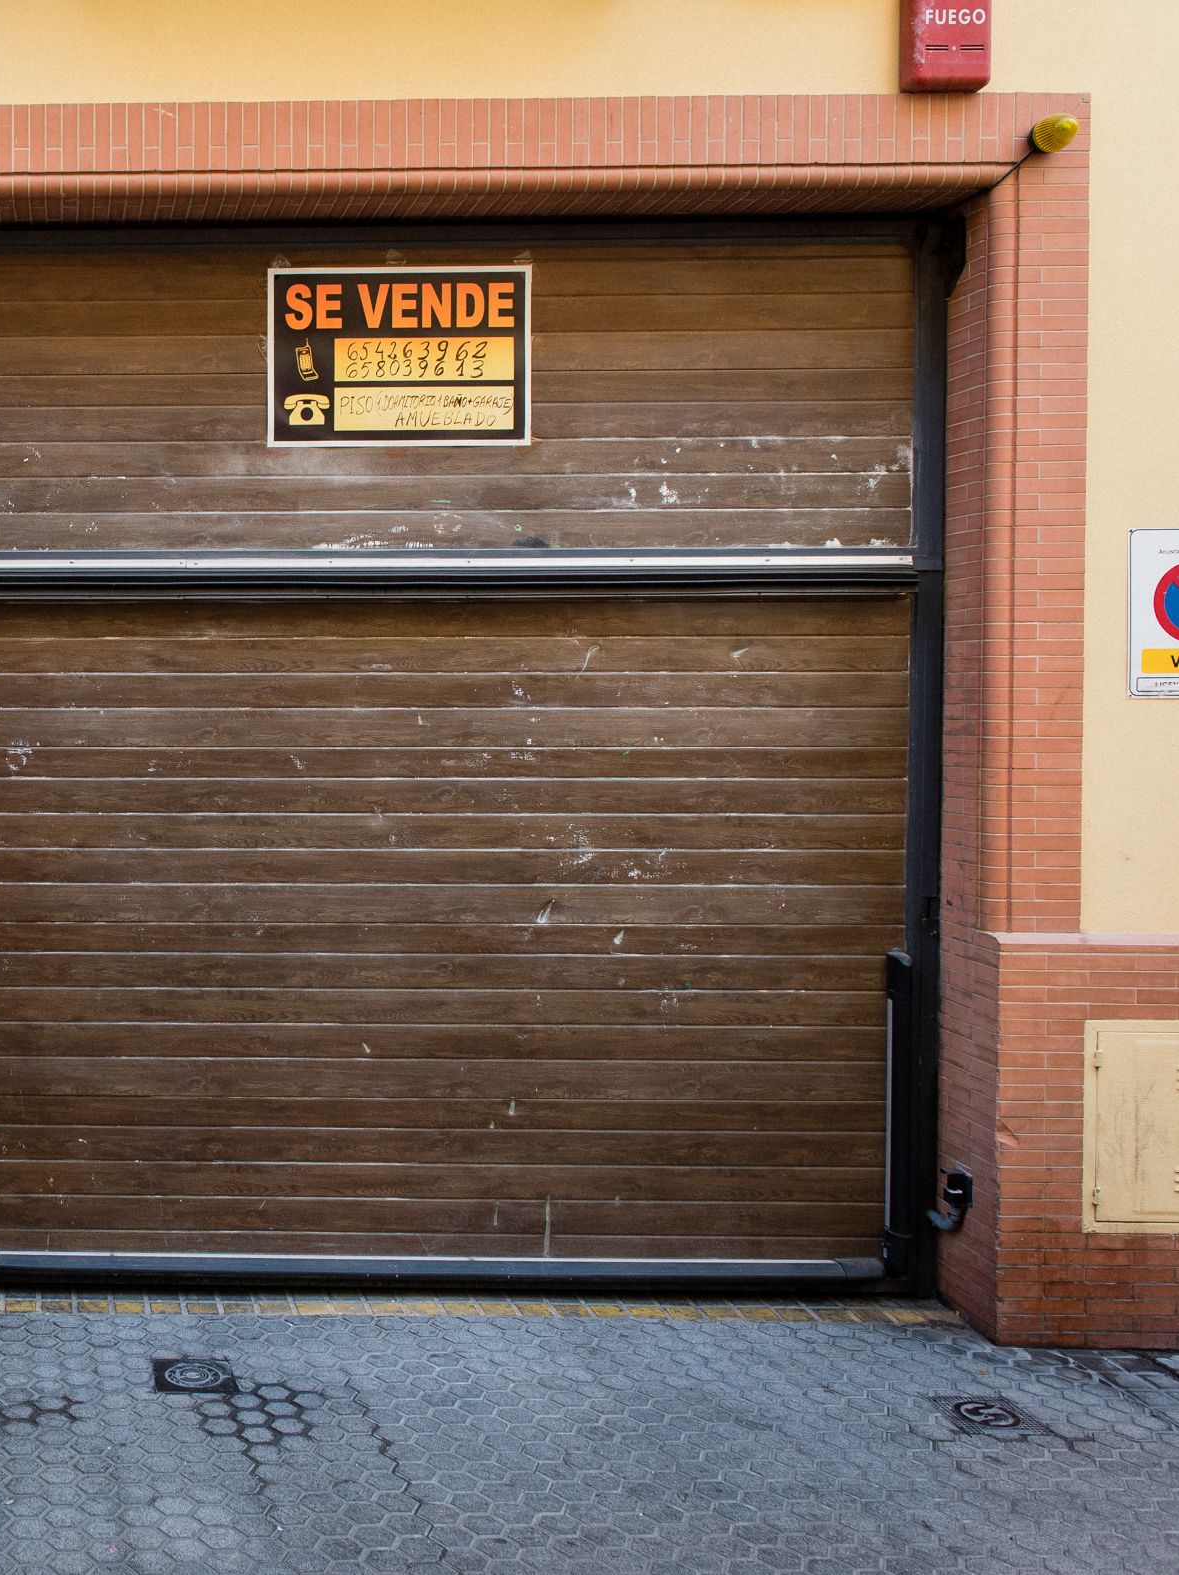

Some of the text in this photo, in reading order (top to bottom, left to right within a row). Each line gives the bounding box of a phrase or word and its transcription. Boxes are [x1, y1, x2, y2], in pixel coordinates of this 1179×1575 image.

[925, 8, 986, 25] FUEGO
[284, 282, 515, 330] SE VENDE
[345, 359, 485, 378] 658039613
[340, 395, 374, 416] PISO
[395, 410, 497, 427] AMUEBLADO
